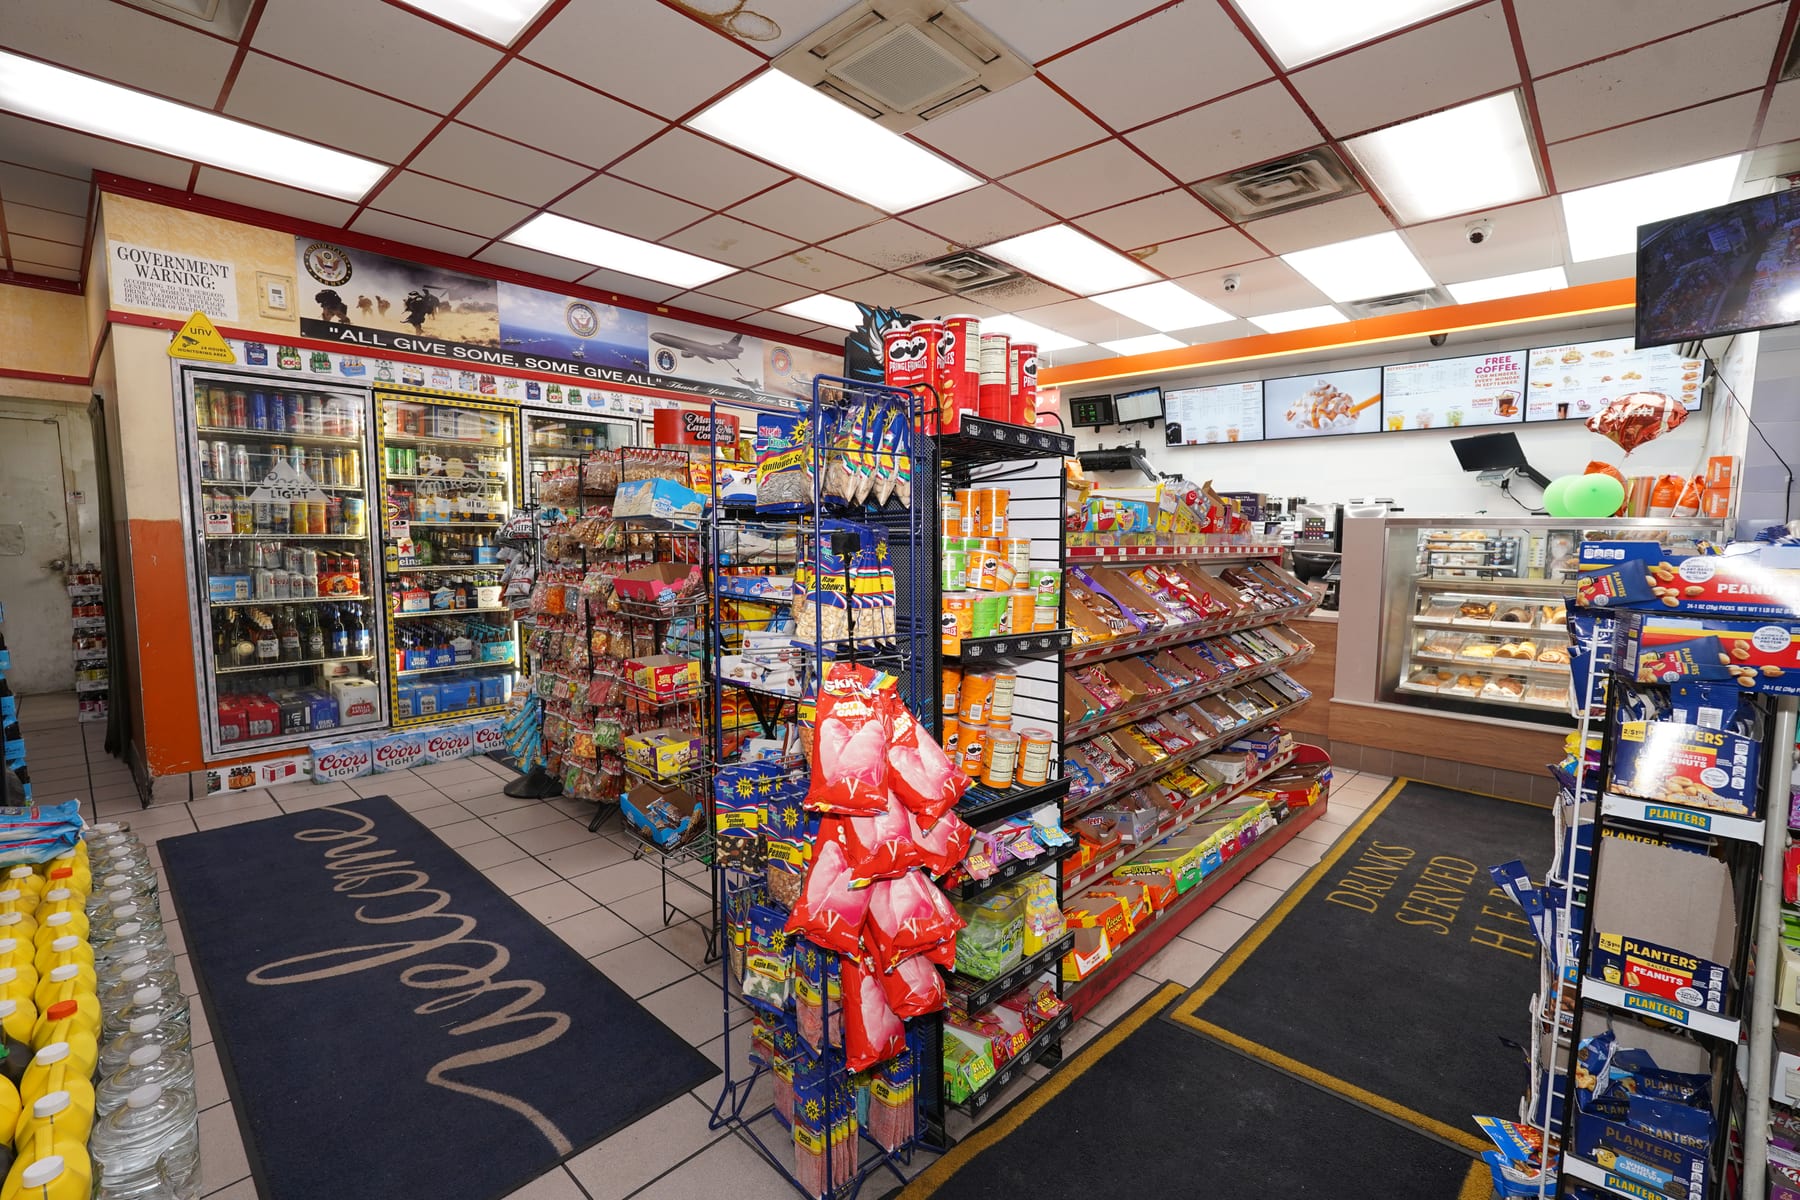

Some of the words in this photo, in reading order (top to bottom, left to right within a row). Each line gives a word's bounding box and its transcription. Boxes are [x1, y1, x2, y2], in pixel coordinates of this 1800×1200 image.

[117, 246, 229, 279] GOVERNMENT
[135, 264, 216, 290] WARNING:
[124, 278, 163, 290] ACCORDING
[178, 286, 191, 294] THE
[124, 287, 147, 297] DRINK
[177, 348, 212, 356] MONITORING
[208, 346, 227, 354] HOURS
[393, 337, 447, 356] GIVE
[452, 345, 520, 368] SOME,
[525, 357, 580, 375] SOME
[584, 367, 624, 383] GIVE
[627, 373, 662, 387] ALL"
[1475, 363, 1521, 374] COFFEE.
[1485, 356, 1511, 366] FREE
[666, 381, 701, 393] Thank
[708, 387, 726, 396] You
[687, 422, 711, 433] Cand
[762, 457, 793, 471] Sunflower
[270, 489, 309, 500] LIGHT
[811, 582, 844, 591] Cshews
[1612, 571, 1627, 597] PLANTERS
[428, 735, 470, 751] Coors
[484, 741, 504, 749] LIGH
[376, 743, 422, 762] Coors
[436, 748, 463, 758] LIGHT
[318, 752, 369, 771] Coors
[385, 756, 415, 768] LIGHT
[328, 765, 361, 778] LIGHT
[1649, 808, 1706, 827] PLANTERS
[769, 848, 790, 860] Peanuts
[1326, 840, 1416, 914] DRINKS
[1395, 855, 1479, 936] SERVED
[754, 959, 766, 968] Apple
[1624, 941, 1697, 970] PLANTERS
[246, 806, 573, 1156] Welcome
[1633, 965, 1684, 985] PEANUTS
[1629, 996, 1684, 1020] PLANTERS
[1012, 1033, 1024, 1047] RIP
[971, 1059, 984, 1072] RIP
[1605, 1126, 1682, 1164] PLANTERS
[1620, 1162, 1662, 1184] CASHEWS
[1625, 1160, 1657, 1176] WHOLE
[1610, 1176, 1664, 1200] PLANTERS
